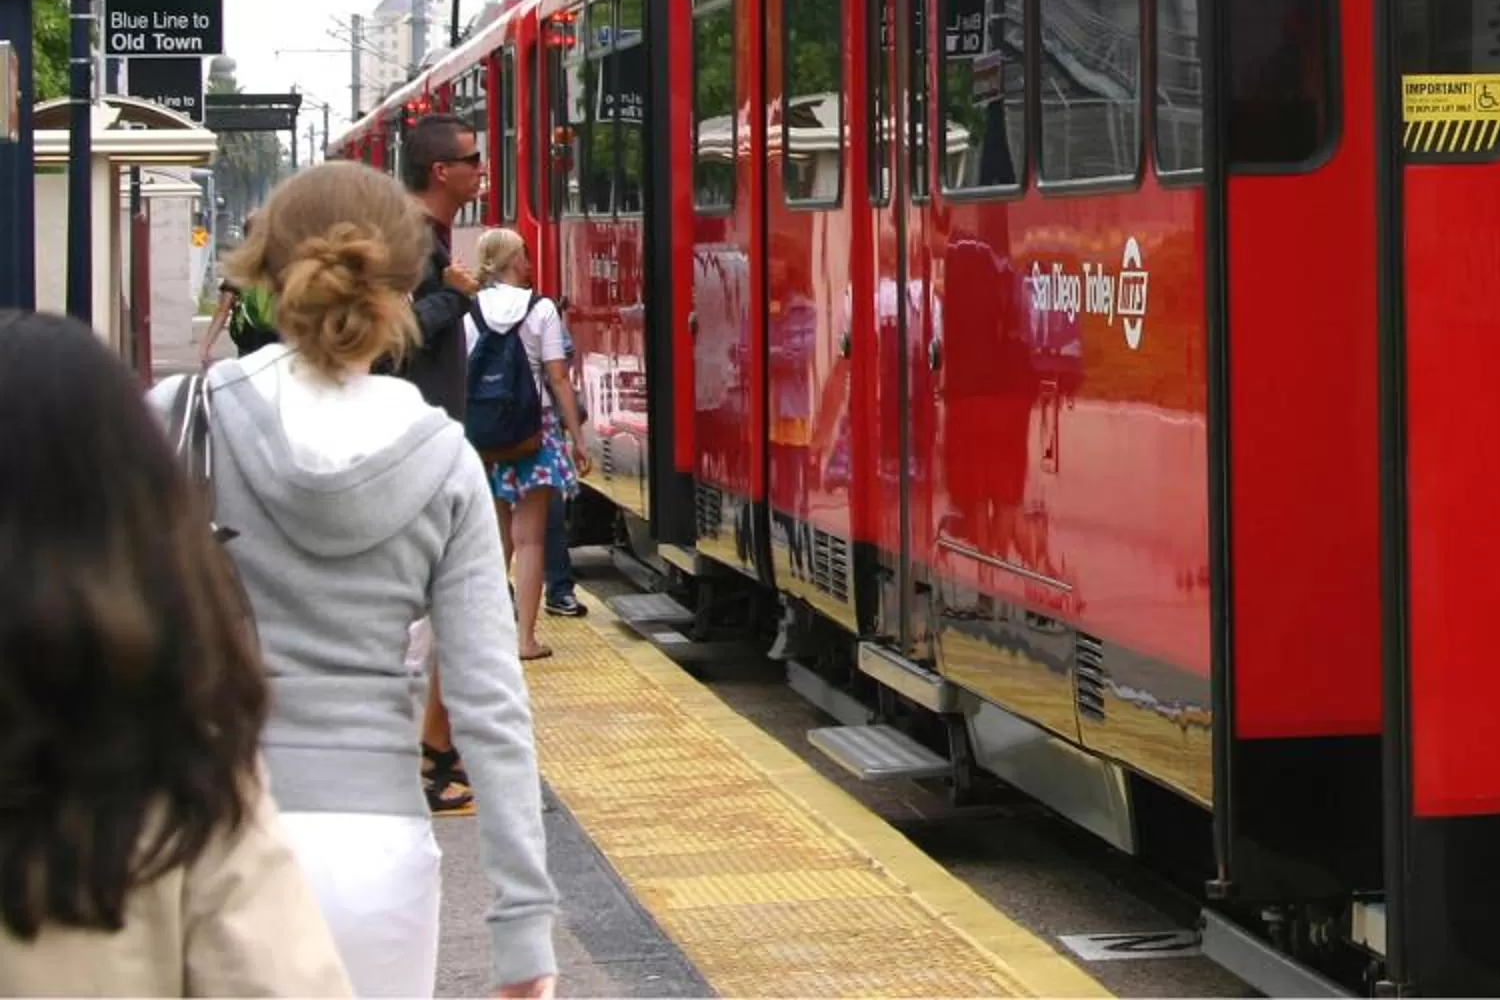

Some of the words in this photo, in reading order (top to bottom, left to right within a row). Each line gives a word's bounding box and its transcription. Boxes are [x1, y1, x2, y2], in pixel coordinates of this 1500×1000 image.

[111, 11, 148, 29] Blue
[153, 11, 188, 29] Line
[193, 13, 209, 29] to
[111, 33, 145, 51] Old
[153, 33, 202, 50] Town
[1052, 263, 1081, 324] Diego
[1083, 263, 1114, 327] Trolley
